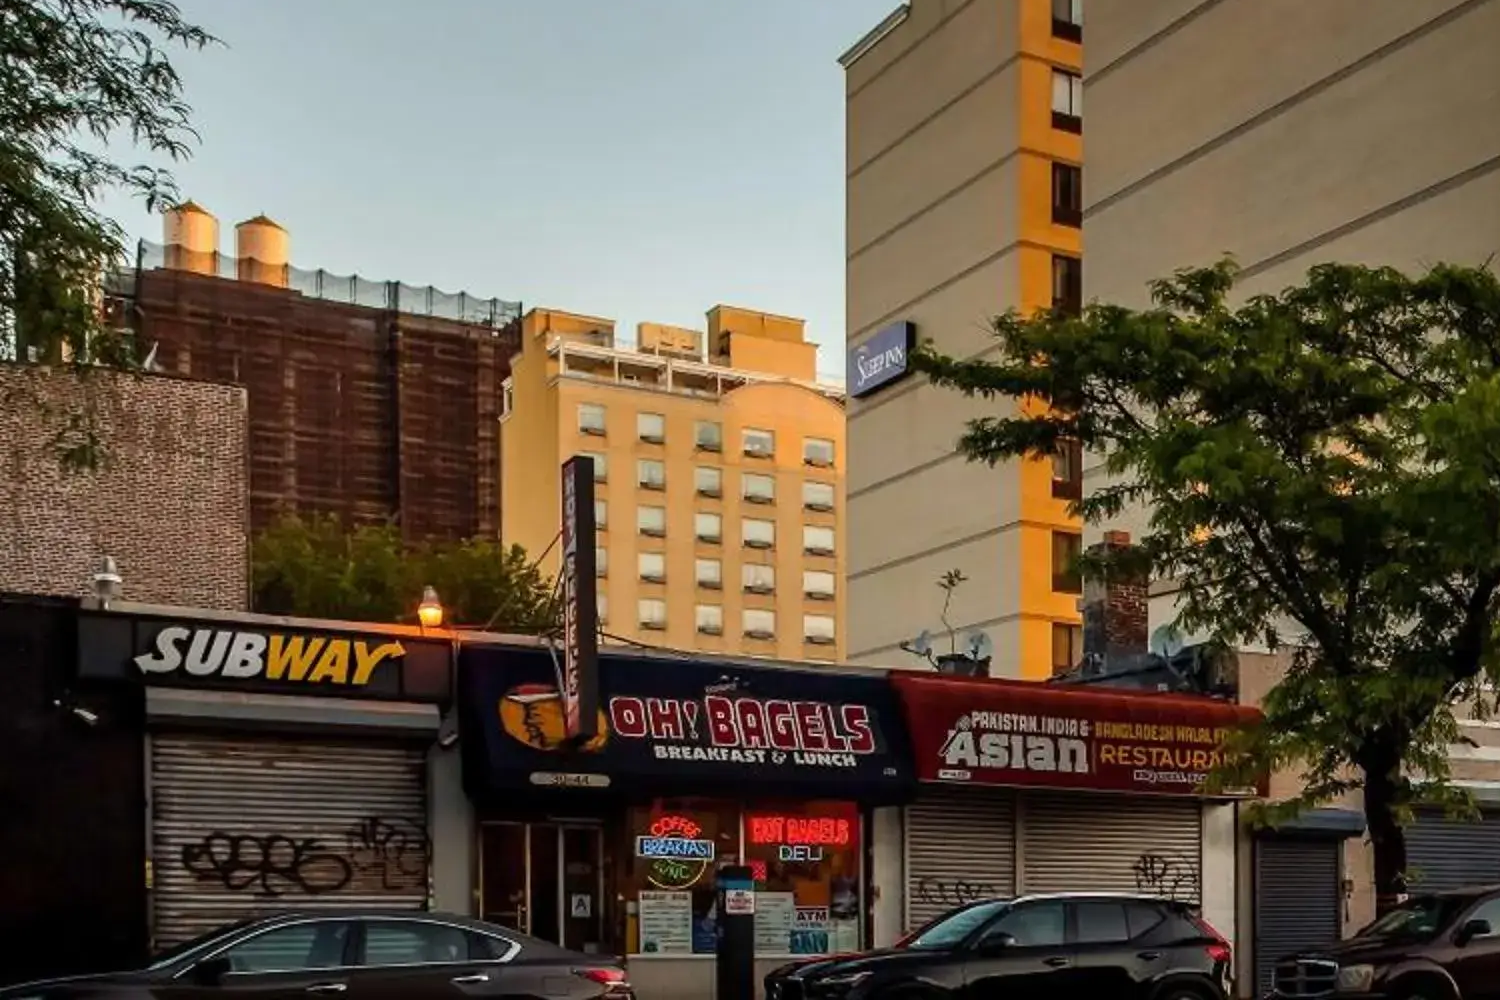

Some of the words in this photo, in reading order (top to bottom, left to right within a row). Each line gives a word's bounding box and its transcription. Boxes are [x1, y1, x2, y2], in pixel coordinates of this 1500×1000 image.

[133, 626, 406, 685] SUBWAY
[609, 696, 698, 739] OH!
[705, 695, 874, 754] BAGELS
[654, 745, 765, 764] BREAKFAST
[772, 752, 787, 765] &
[794, 751, 856, 767] LUNCH
[946, 731, 1088, 773] Asian
[752, 817, 784, 843] HOT
[787, 818, 848, 844] BAGELS
[779, 845, 823, 861] DELI
[574, 897, 587, 911] A
[797, 911, 827, 921] ATM
